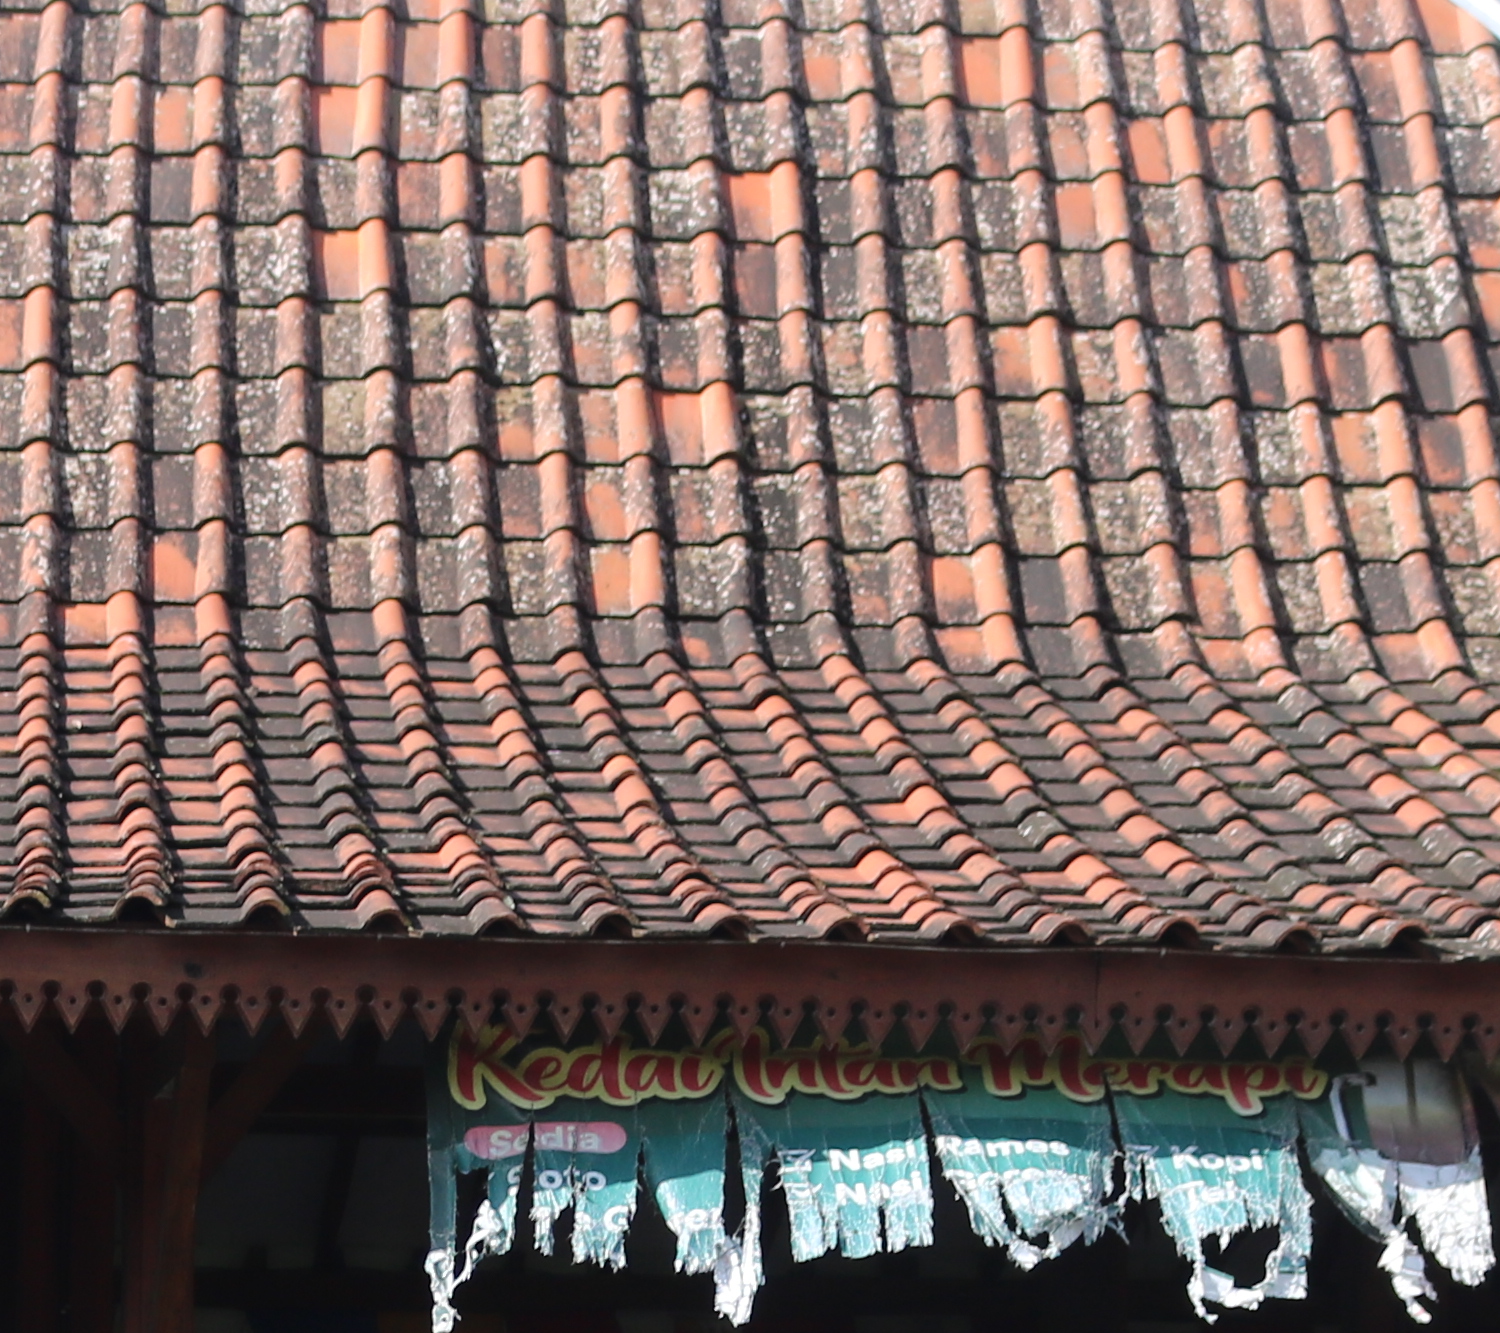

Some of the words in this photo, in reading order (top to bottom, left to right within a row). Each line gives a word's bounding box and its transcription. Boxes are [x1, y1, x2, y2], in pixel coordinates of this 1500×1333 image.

[449, 1030, 727, 1108] Kedai
[730, 1034, 962, 1104] Intan
[966, 1033, 1328, 1116] Merapi
[489, 1125, 602, 1155] Sedia
[829, 1139, 917, 1171] Nasi
[1171, 1146, 1264, 1174] Kopi
